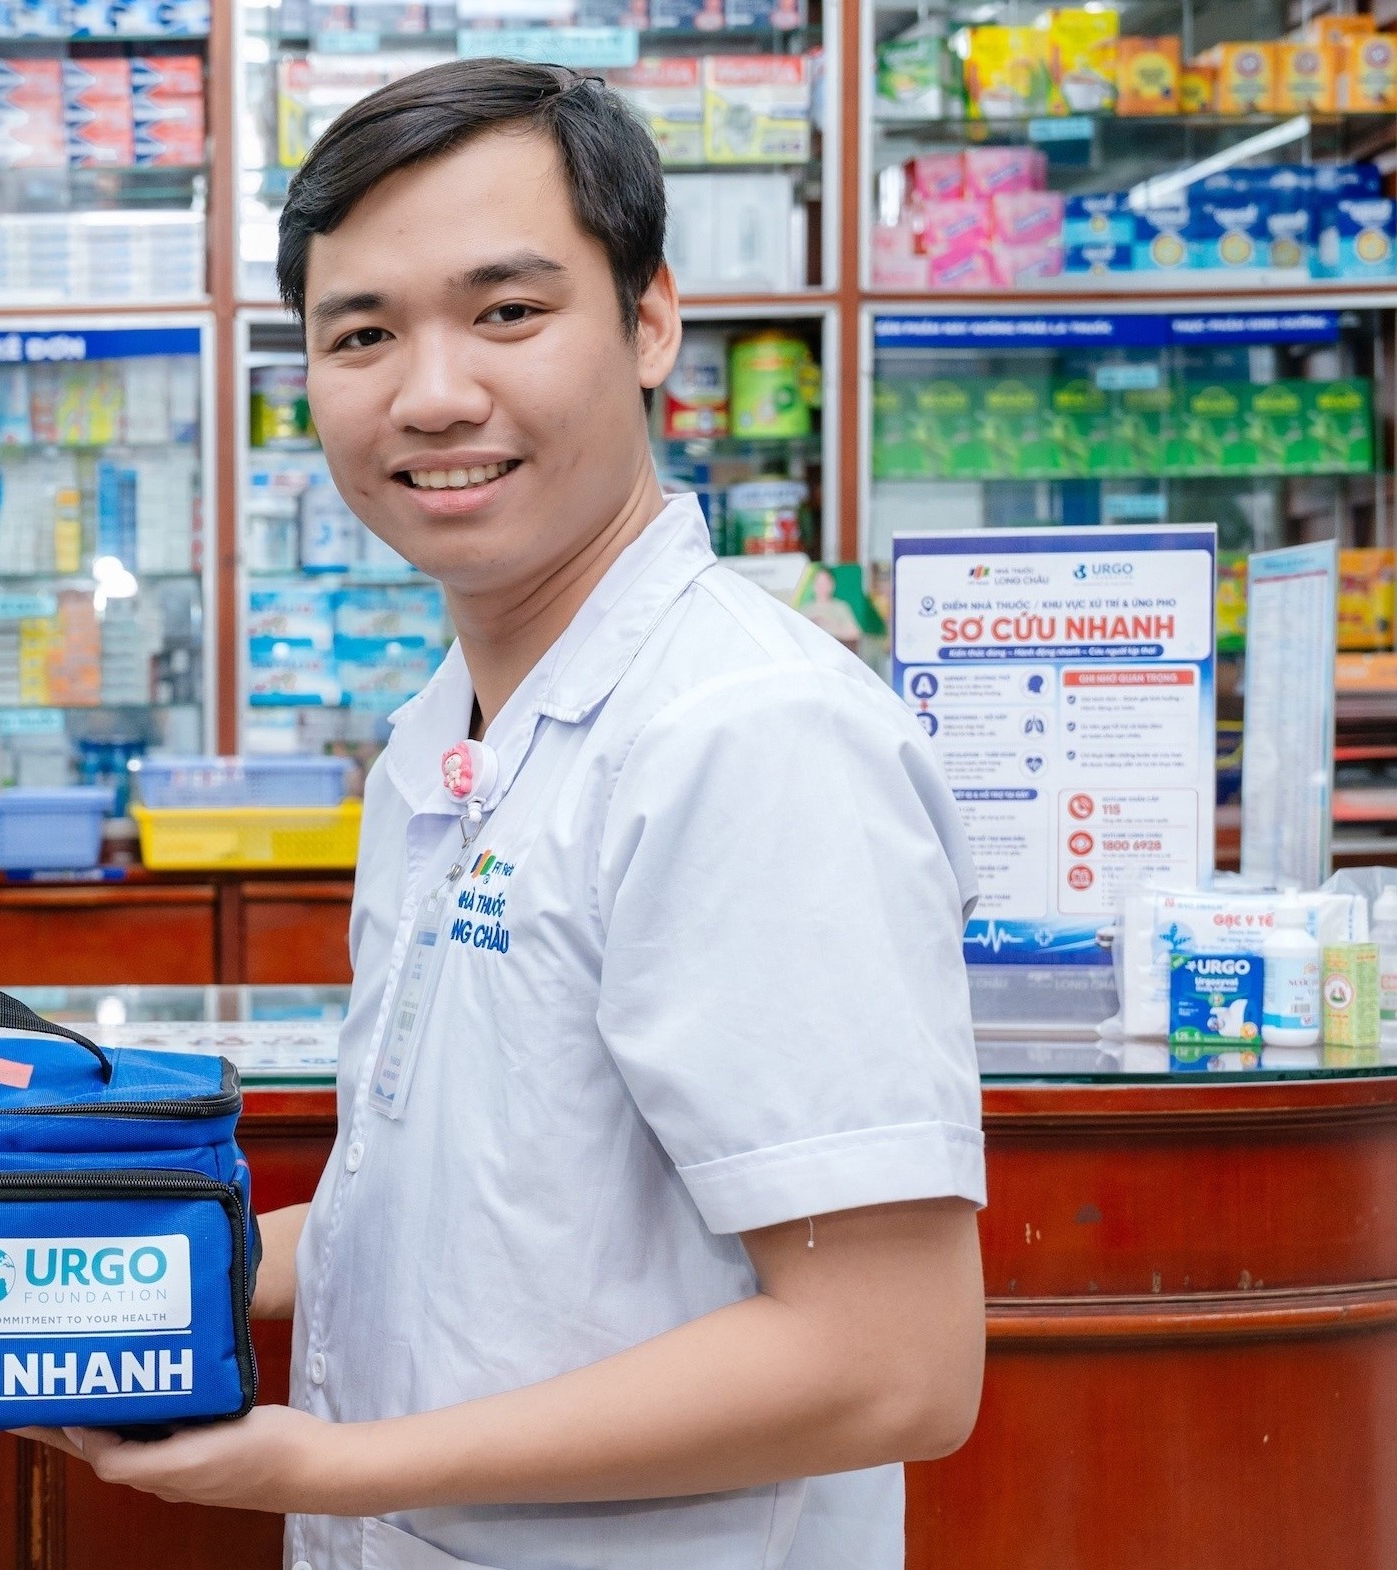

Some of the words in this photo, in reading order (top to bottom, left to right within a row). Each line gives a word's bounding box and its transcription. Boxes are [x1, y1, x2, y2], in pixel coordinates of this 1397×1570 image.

[1091, 562, 1133, 575] URGO
[970, 600, 992, 610] NHÀ
[996, 598, 1030, 610] THUỐC
[1042, 600, 1062, 610] KHU
[941, 615, 984, 642] SƠ
[991, 611, 1056, 642] CỨU
[1065, 613, 1176, 641] NHANH
[915, 676, 934, 694] A
[1102, 804, 1121, 815] 115
[1102, 840, 1129, 851] 1800
[1133, 840, 1162, 851] 6928
[476, 890, 506, 918] THUỐC
[450, 918, 473, 944] NG
[473, 920, 509, 954] CHÂU
[1197, 958, 1251, 975] URGO
[25, 1246, 167, 1286] URGO
[24, 1289, 167, 1304] FOUNDATION
[67, 1315, 82, 1324] TO
[87, 1314, 117, 1324] YOUR
[122, 1313, 167, 1322] HEALTH
[4, 1349, 194, 1395] NHANH
